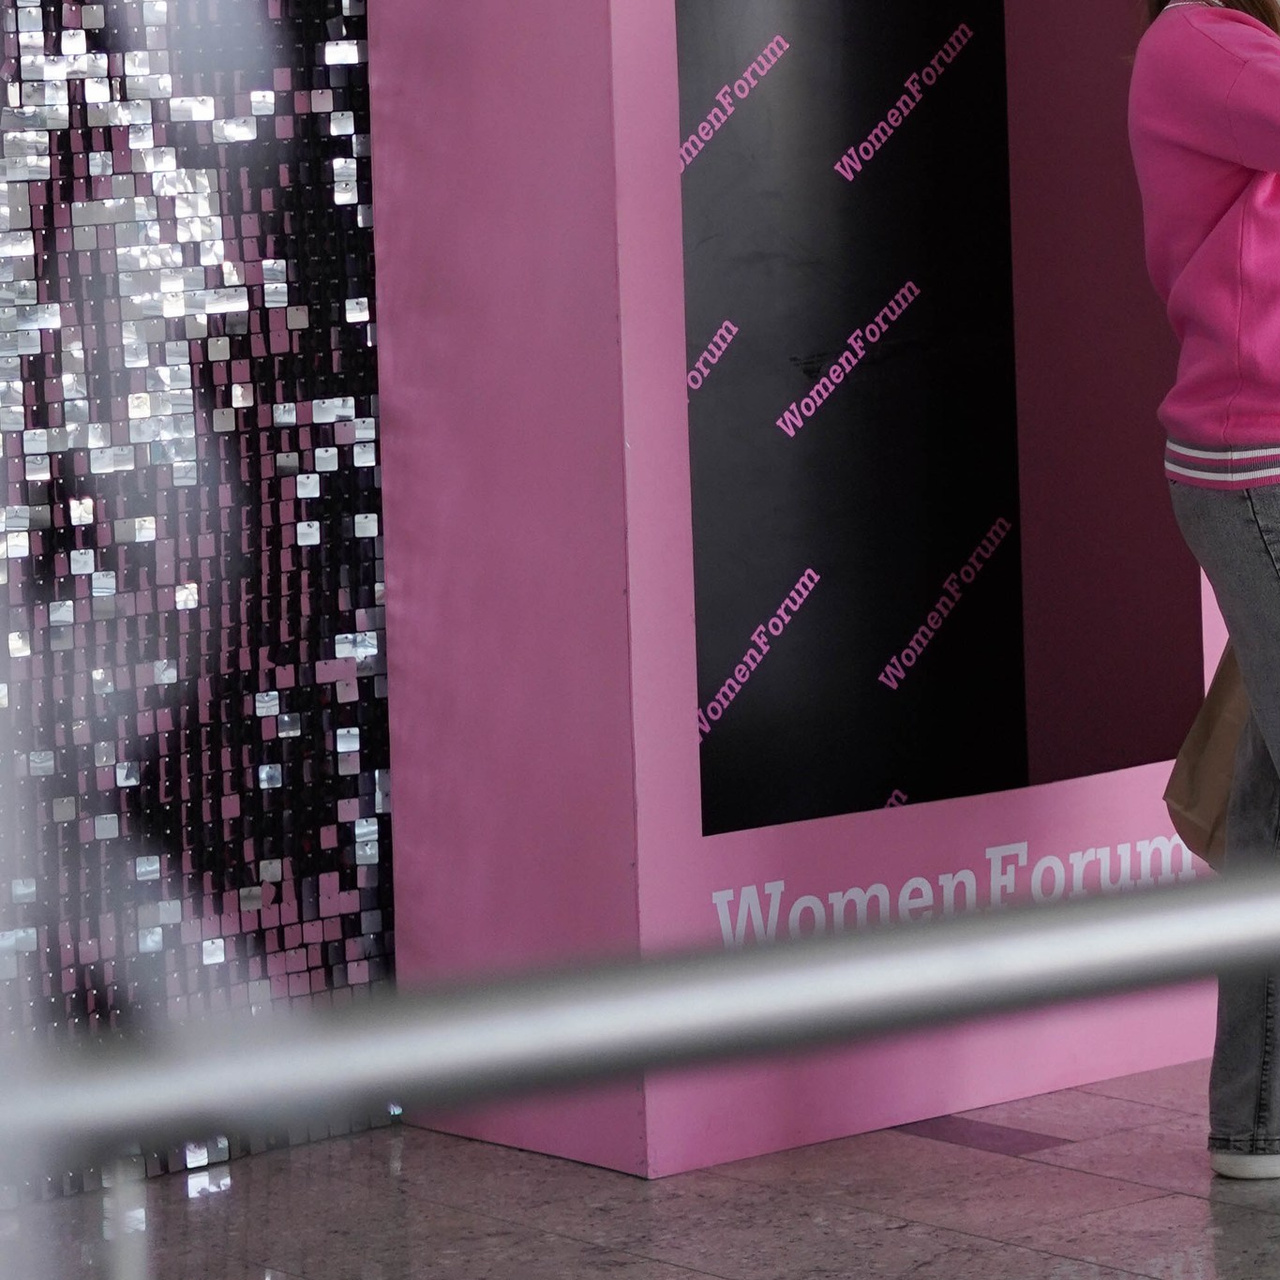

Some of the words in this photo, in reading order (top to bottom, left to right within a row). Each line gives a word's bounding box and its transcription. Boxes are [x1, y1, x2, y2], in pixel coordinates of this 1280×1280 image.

[680, 35, 790, 174] menForum
[833, 23, 973, 182] WomenForum
[775, 280, 921, 438] WomenForum
[878, 517, 1012, 692] WomenForum
[712, 832, 1197, 951] WomenForum
